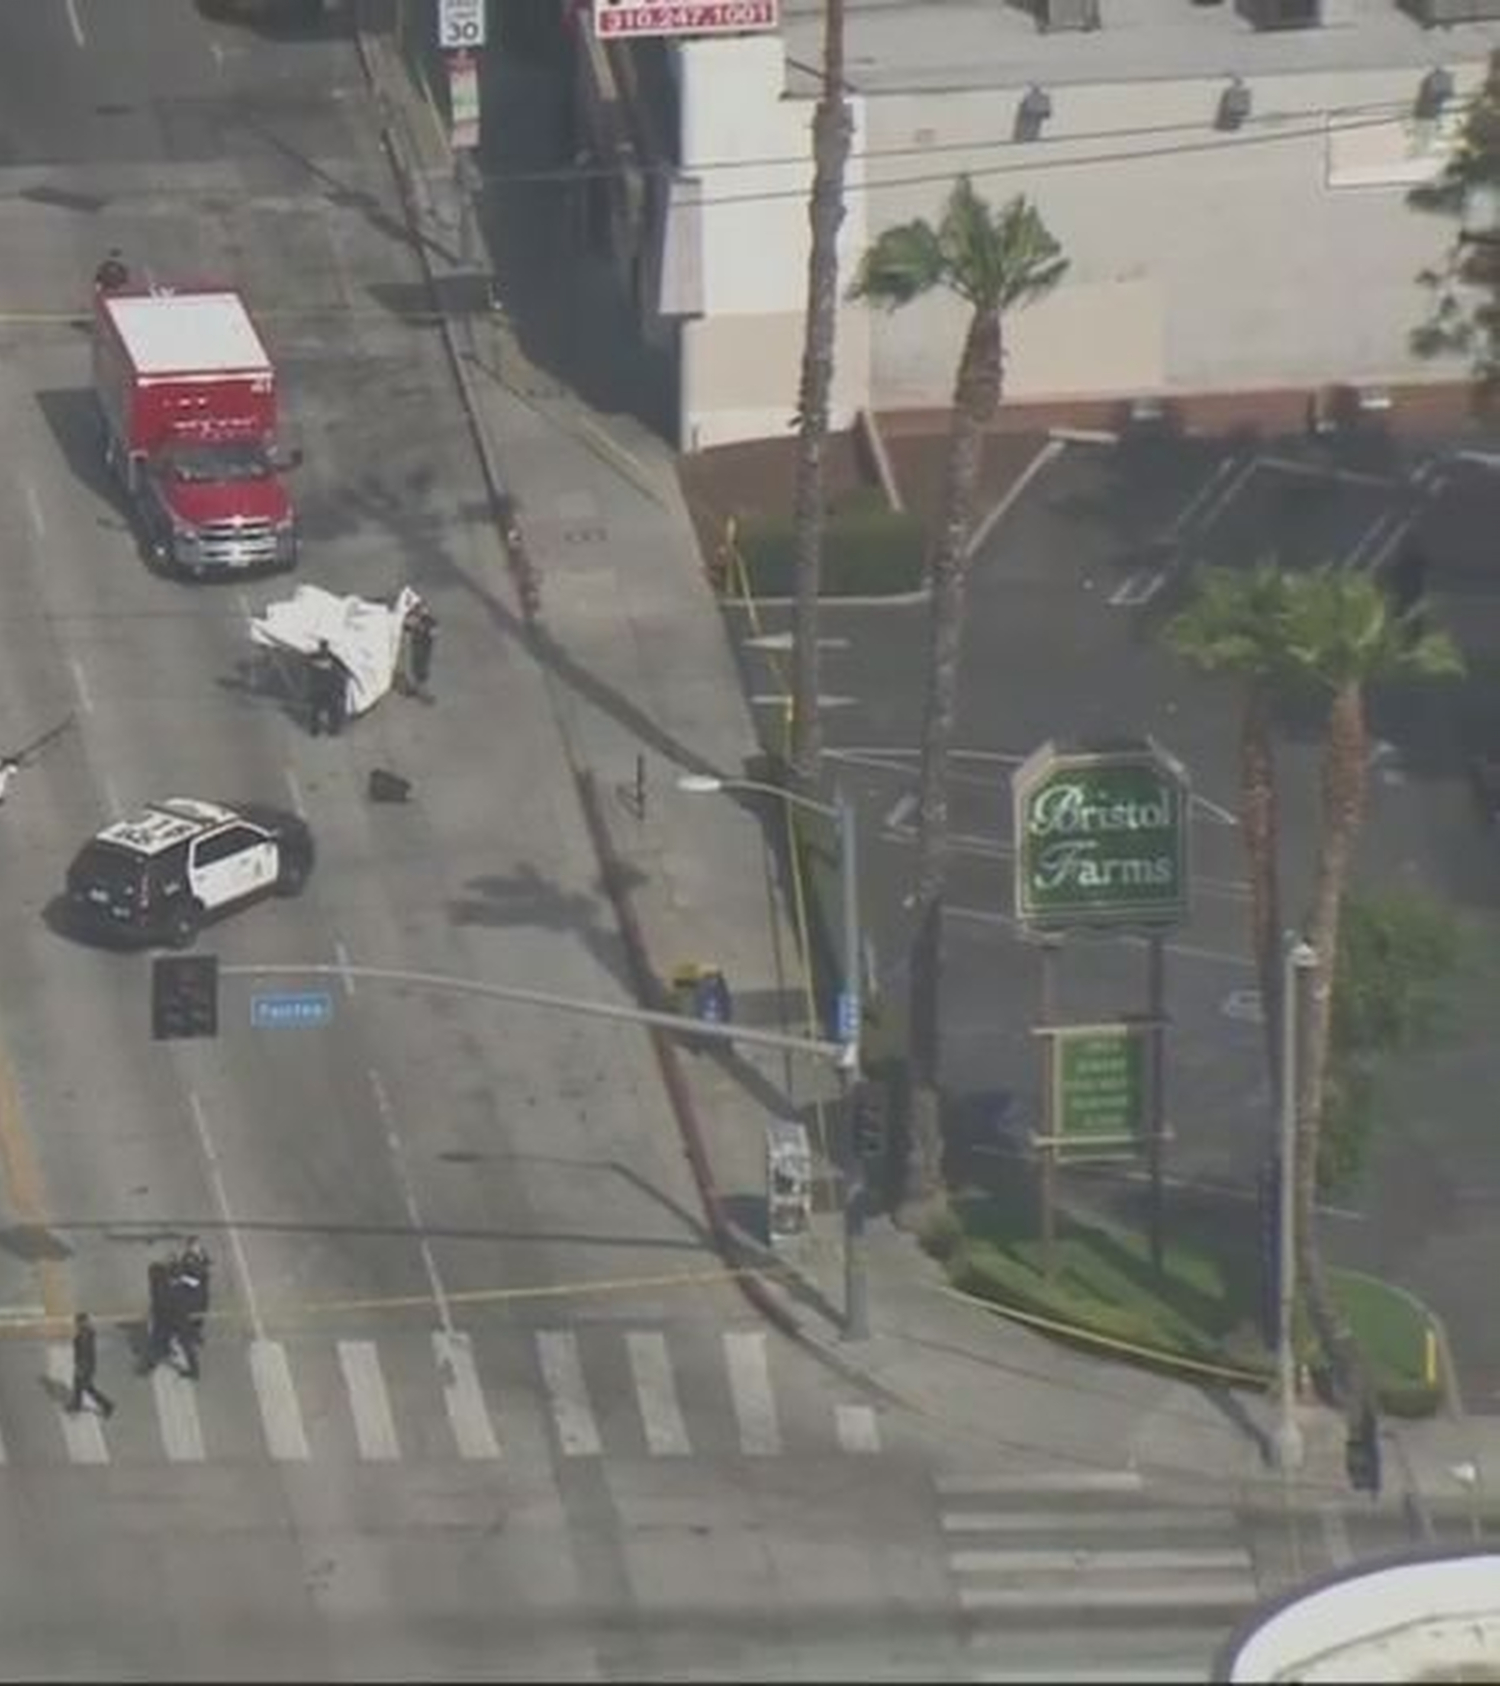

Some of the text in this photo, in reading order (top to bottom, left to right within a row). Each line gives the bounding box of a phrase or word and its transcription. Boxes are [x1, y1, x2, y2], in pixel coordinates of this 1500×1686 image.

[446, 21, 479, 40] 30
[1029, 784, 1171, 836] Bristol
[1034, 840, 1174, 889] Farms
